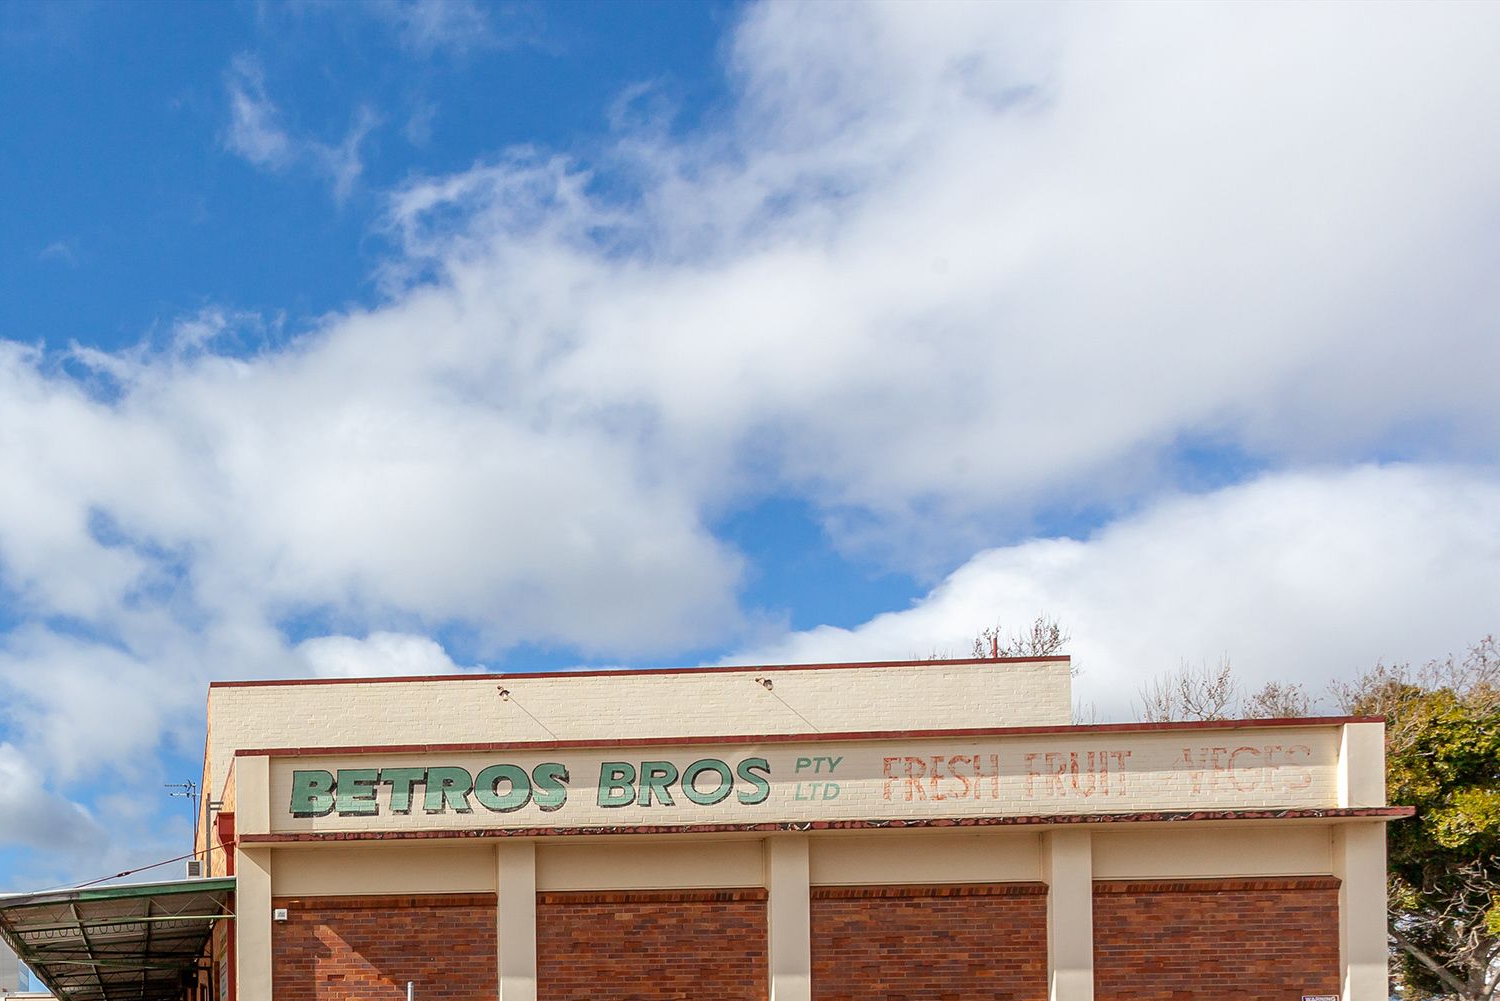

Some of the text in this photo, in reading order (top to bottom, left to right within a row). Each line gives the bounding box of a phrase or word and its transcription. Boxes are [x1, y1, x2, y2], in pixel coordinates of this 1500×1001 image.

[795, 756, 843, 774] PTY
[883, 753, 999, 801] FRESH
[1024, 750, 1132, 798] FRUIT
[289, 757, 771, 818] BETROS BROS
[795, 783, 841, 801] LTD
